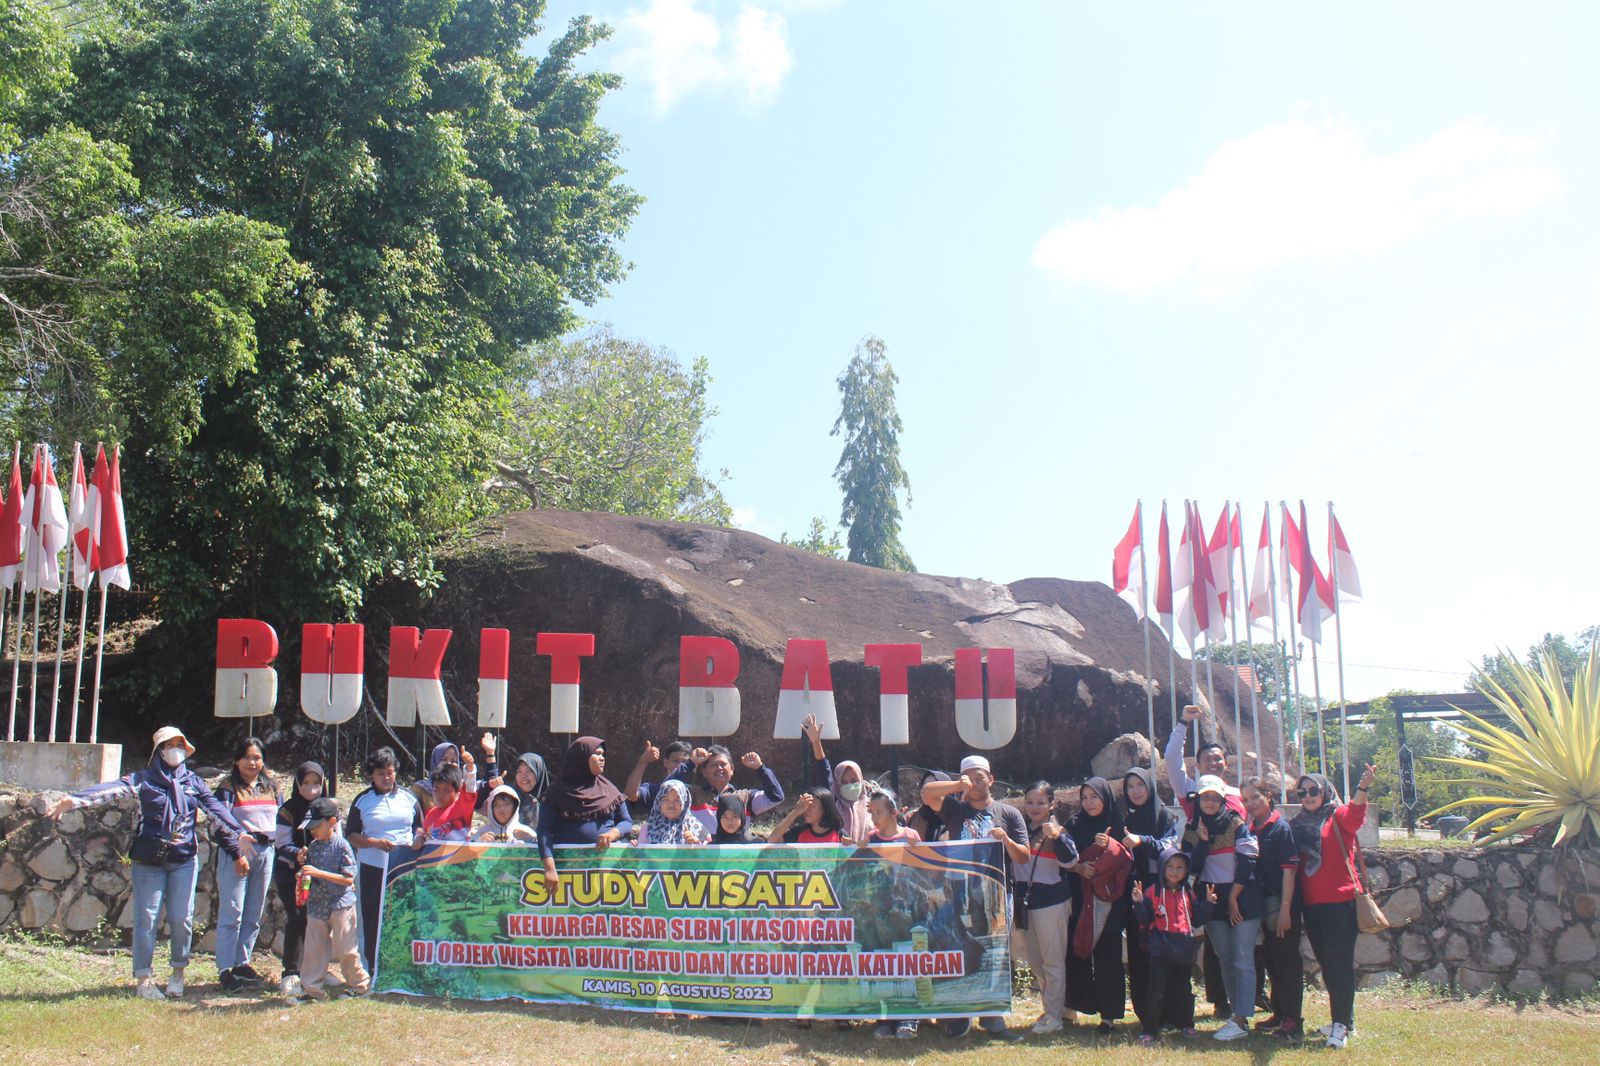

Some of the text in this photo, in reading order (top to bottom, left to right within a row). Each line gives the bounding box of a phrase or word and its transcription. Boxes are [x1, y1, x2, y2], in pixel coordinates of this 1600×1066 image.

[214, 618, 1017, 750] BUKIT BATU
[521, 869, 841, 911] STUDY WISATA
[508, 915, 854, 943] KELUARGA BESAR SLBN 1 KASONGAN
[412, 942, 964, 976] DI OBJEK WISATA BUKIT BATU DAN KEBUN RAYA KATINGAN
[583, 979, 773, 1000] KAMIS, 10 AGUSTUS 2023
